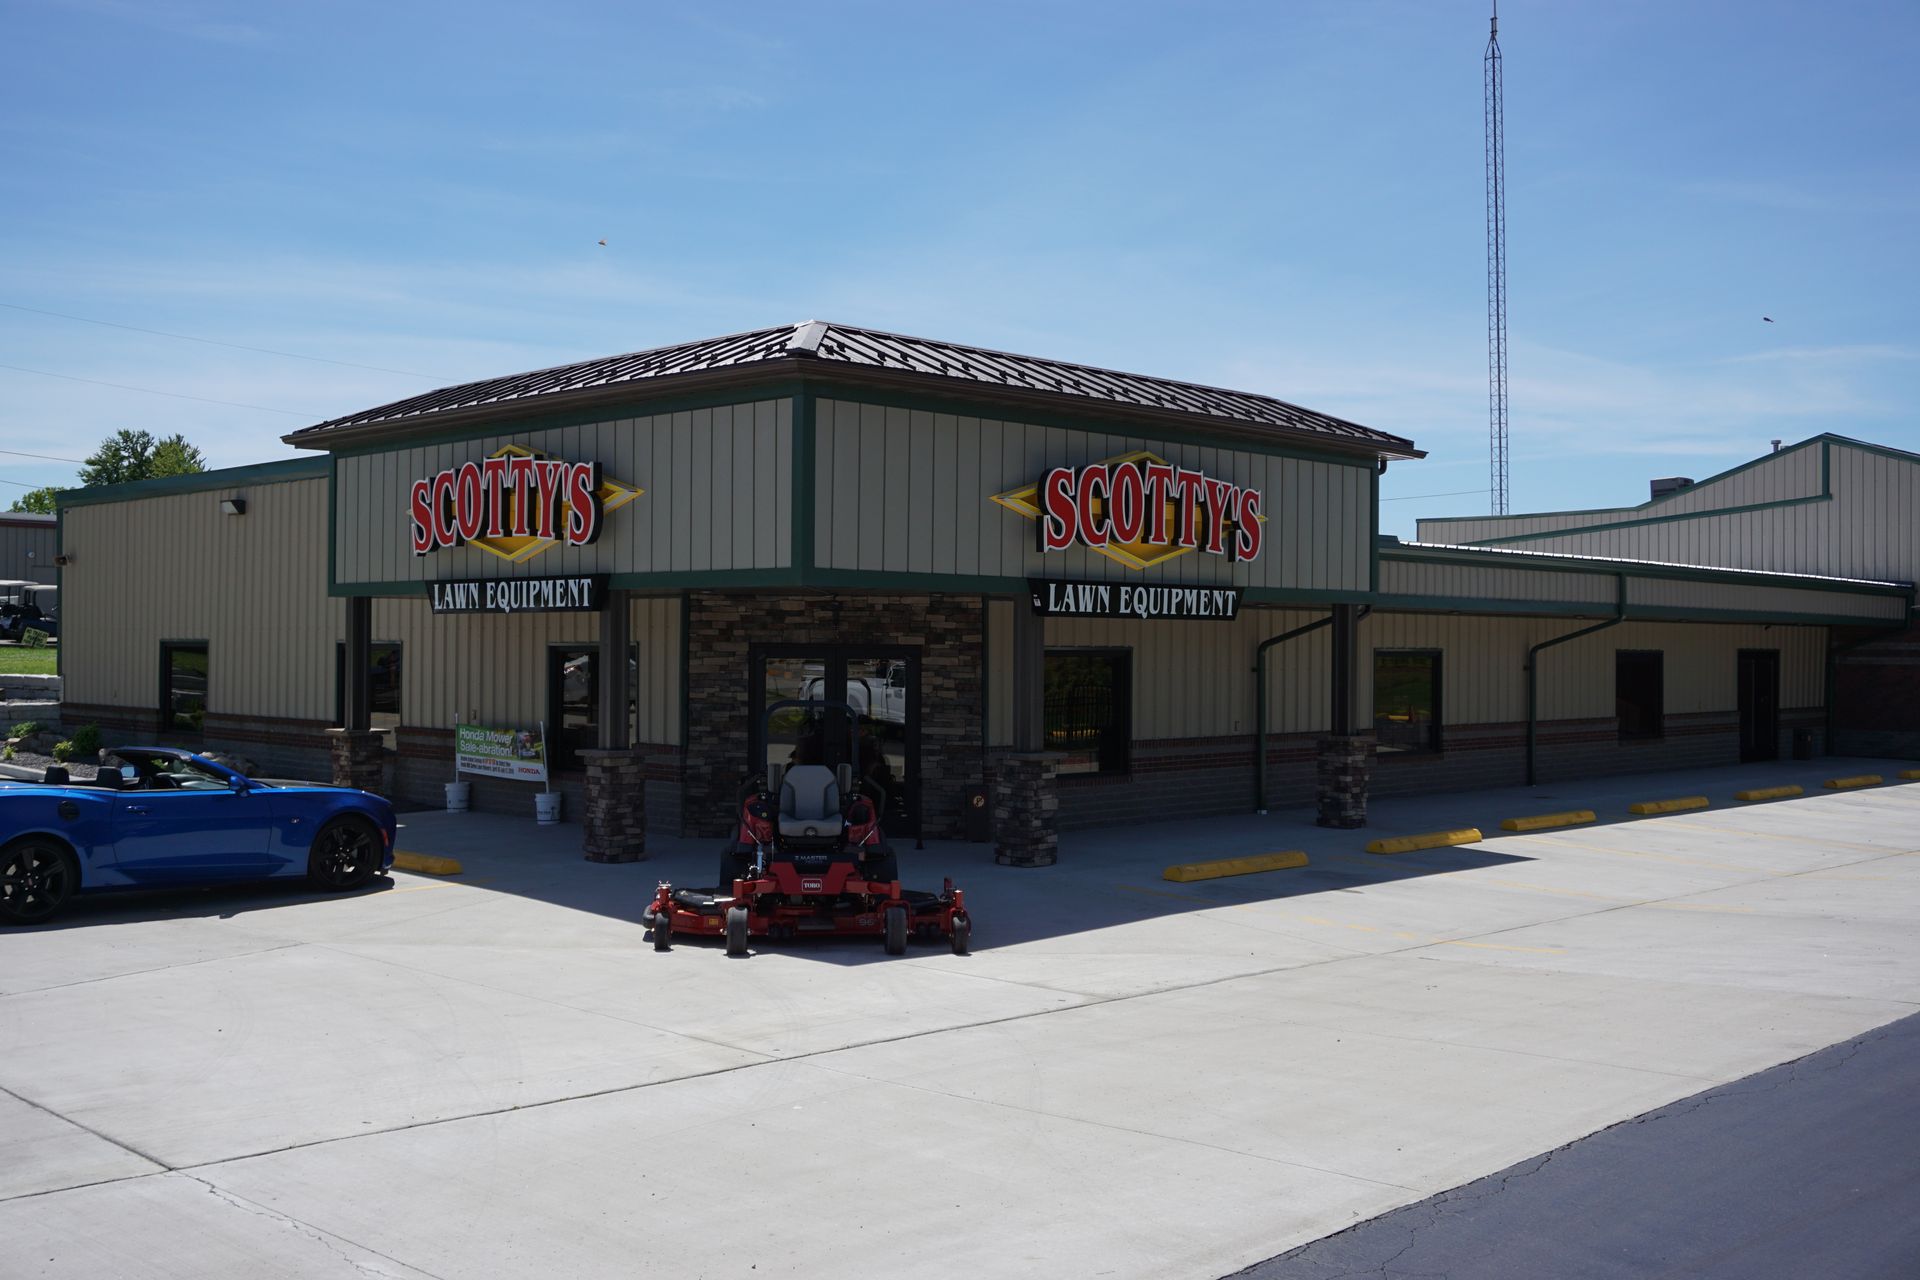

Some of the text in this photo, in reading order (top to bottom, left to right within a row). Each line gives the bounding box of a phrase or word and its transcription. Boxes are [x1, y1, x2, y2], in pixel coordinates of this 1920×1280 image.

[411, 454, 601, 556] SCOTTY'S
[1043, 461, 1262, 562] SCOTTY'S
[433, 578, 593, 614] LAWN EQUIPMENT
[1048, 583, 1237, 619] LAWN EQUIPMENT
[460, 728, 513, 744] Honda Mower
[460, 741, 512, 756] Sale-abration!
[518, 767, 540, 775] HONDA
